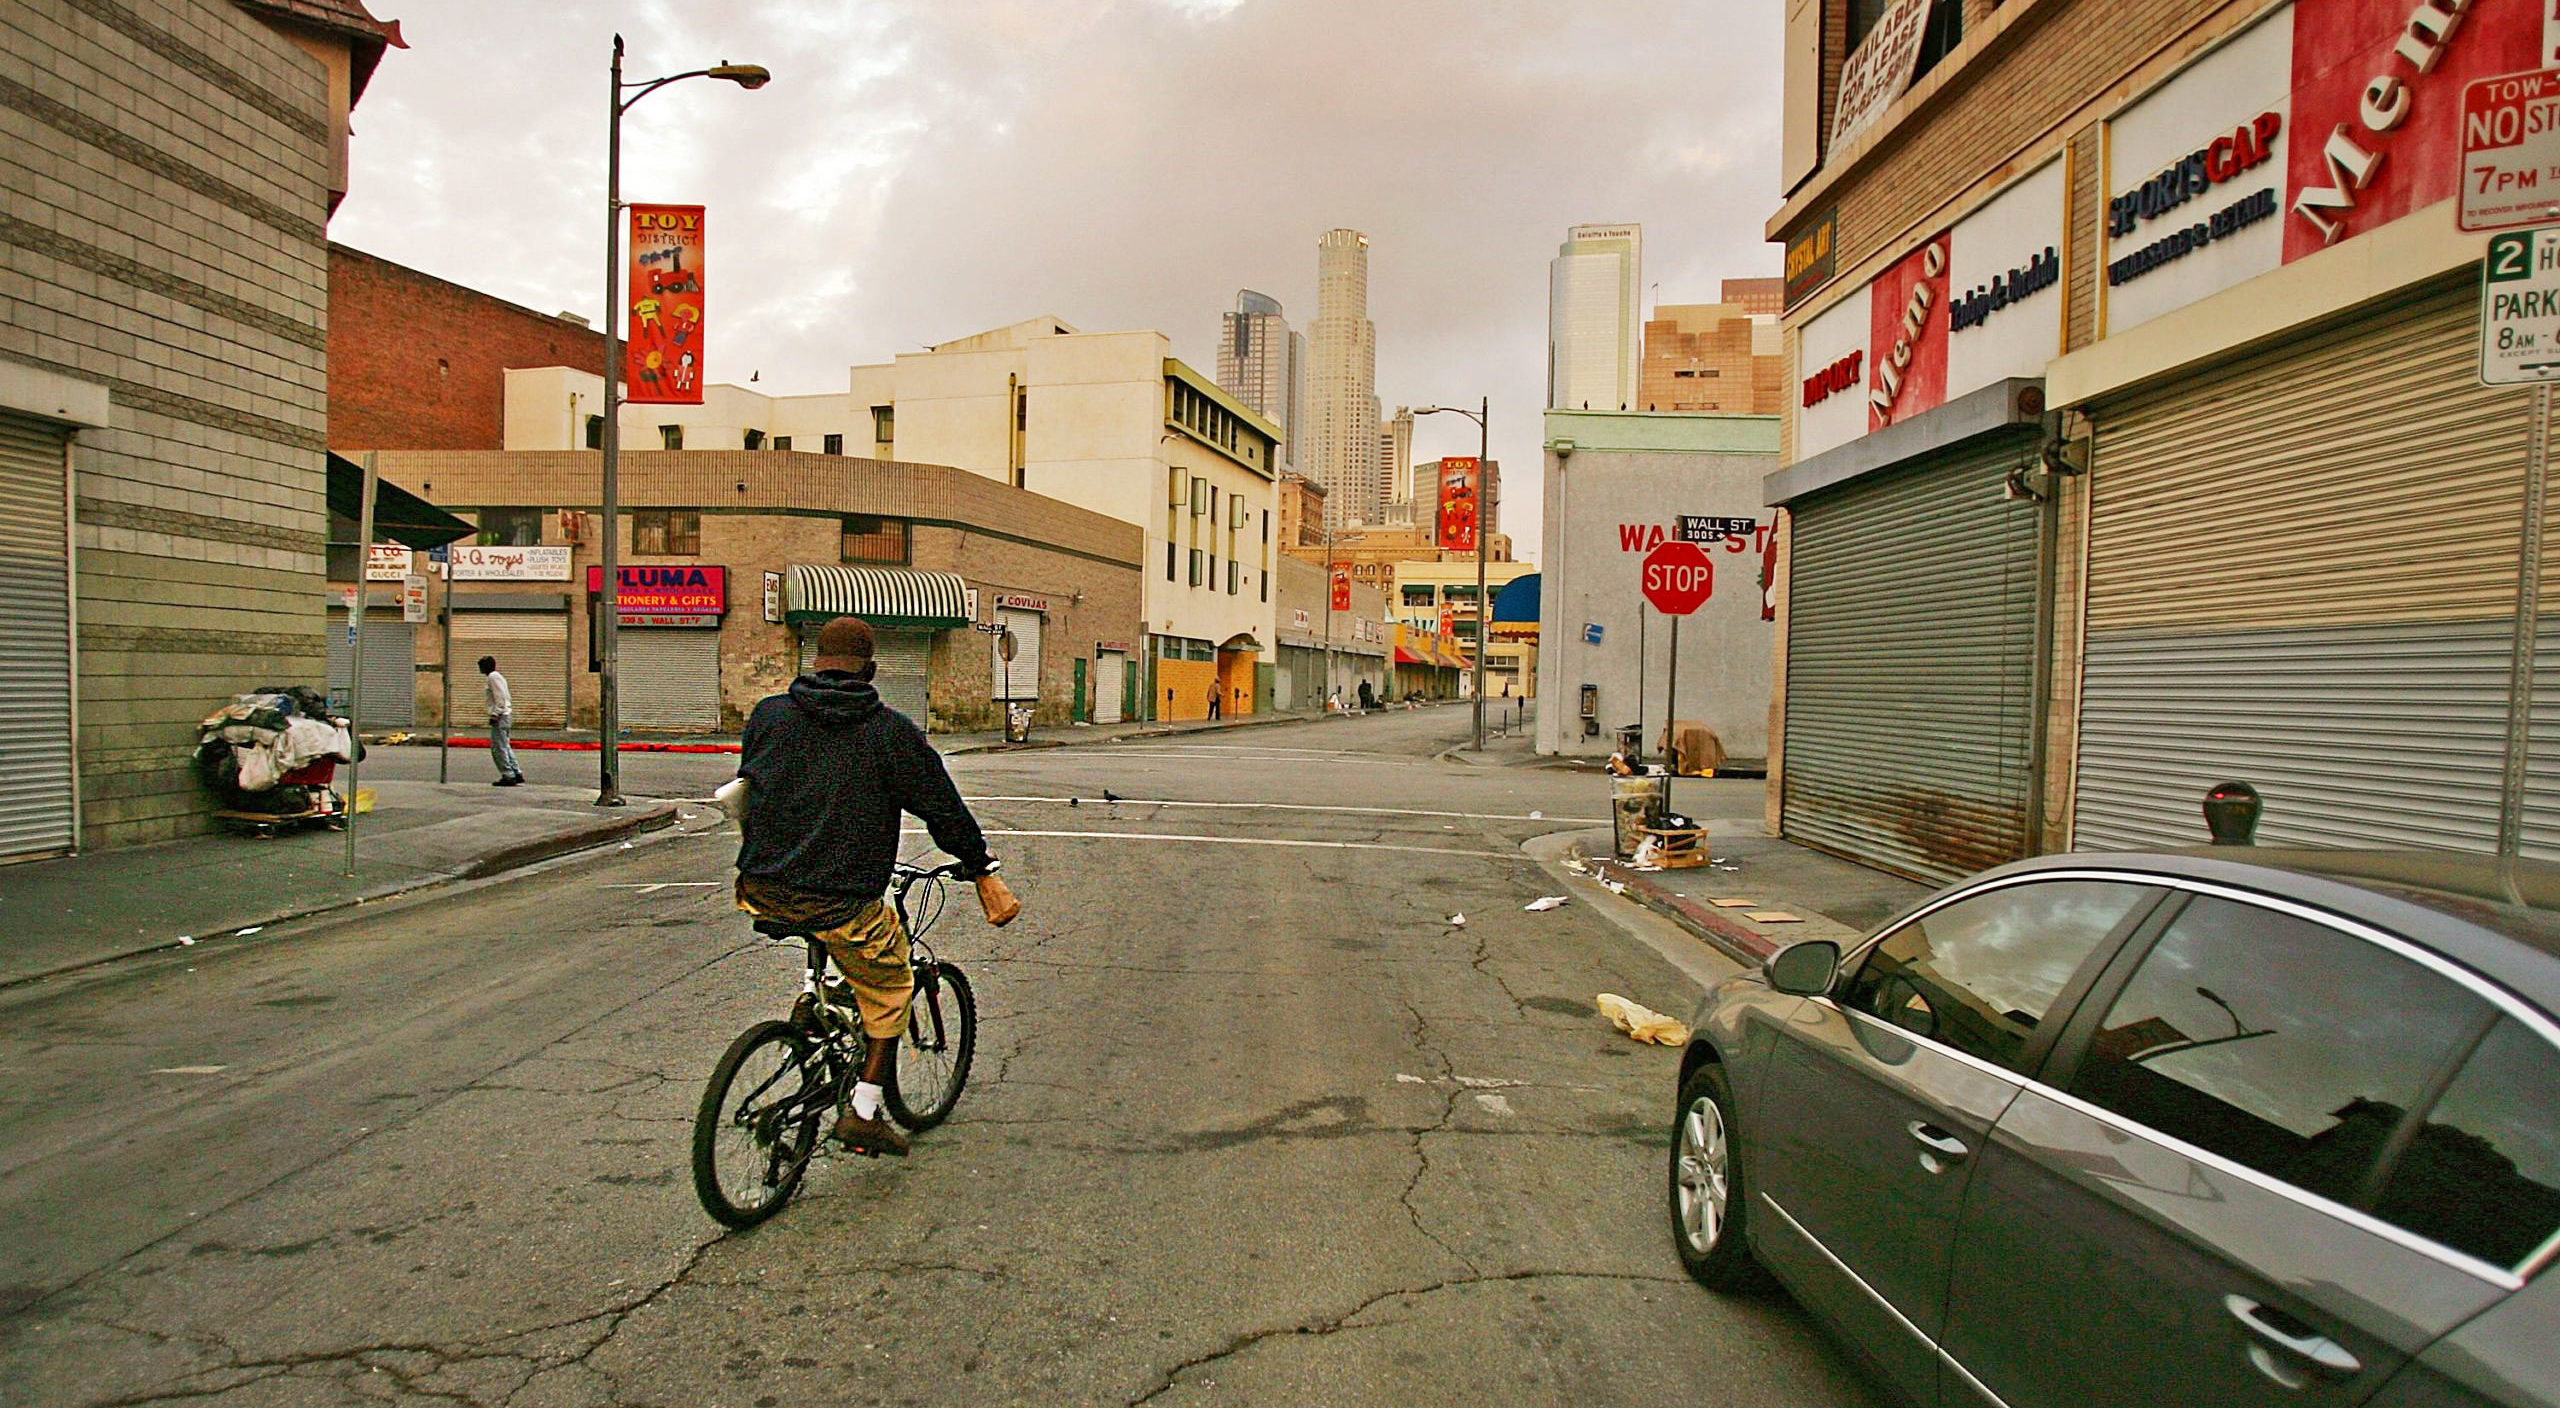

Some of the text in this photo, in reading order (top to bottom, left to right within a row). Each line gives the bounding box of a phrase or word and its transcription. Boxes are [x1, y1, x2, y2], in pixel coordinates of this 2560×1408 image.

[1841, 13, 1920, 112] FOR LEASE
[2467, 103, 2560, 148] NO ST
[637, 213, 700, 231] TOY
[638, 232, 698, 246] DISTRICT
[2193, 223, 2210, 247] &
[2496, 240, 2560, 275] 2 H
[2493, 288, 2560, 321] PARK
[1870, 242, 1946, 427] Memo
[1803, 349, 1863, 408] IMPORT
[1446, 460, 1474, 469] TOY
[1687, 517, 1725, 531] WALL
[371, 571, 401, 579] GUCCI
[1647, 564, 1708, 592] STOP
[669, 595, 679, 605] &
[682, 595, 717, 605] GIFTS
[1008, 596, 1048, 610] COVIJAS
